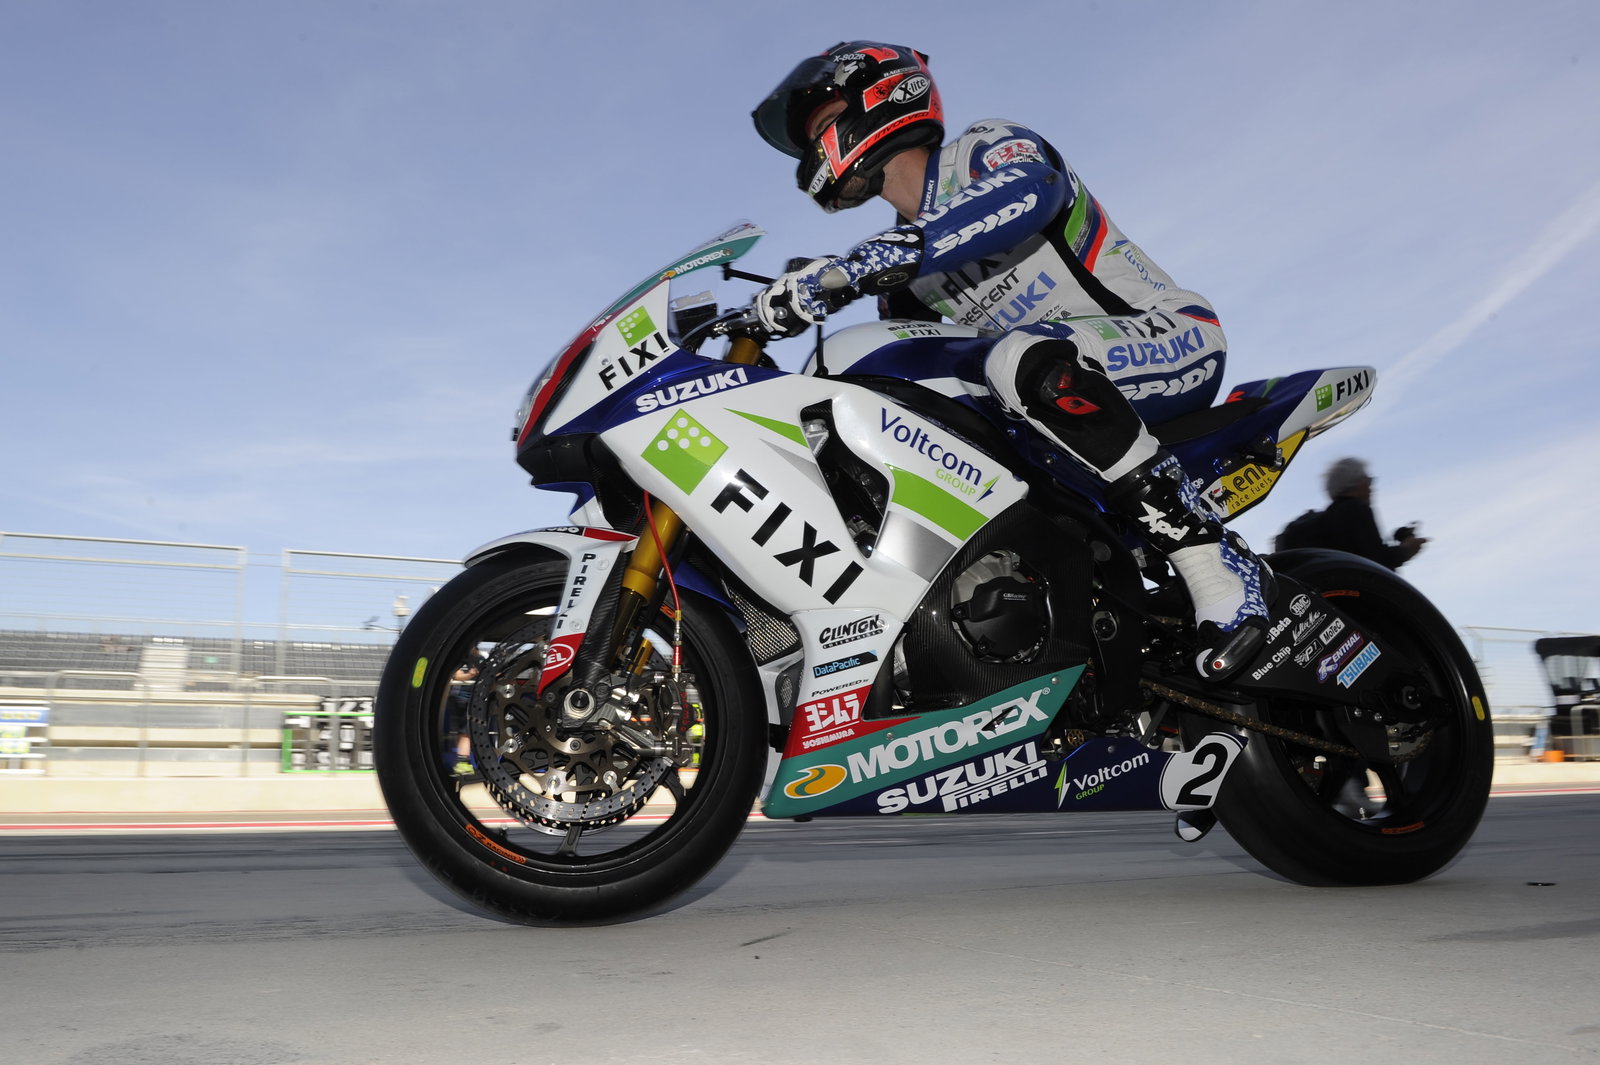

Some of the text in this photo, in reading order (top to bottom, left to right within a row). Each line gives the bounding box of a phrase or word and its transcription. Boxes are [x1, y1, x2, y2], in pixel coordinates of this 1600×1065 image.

[811, 174, 825, 191] FIXI
[922, 179, 935, 212] SUZUKI
[932, 193, 1038, 259] SPIDI
[674, 249, 727, 274] MOTOREX
[957, 267, 1020, 327] RESCENT
[888, 323, 933, 331] SUZUKI
[1110, 312, 1177, 339] FIXI
[598, 331, 670, 391] FIXI
[1106, 326, 1205, 372] SUZUKI
[635, 367, 749, 413] SUZUKI
[1335, 369, 1370, 402] FIXI
[881, 407, 982, 486] Voltcom
[935, 468, 977, 497] GROUP
[1231, 477, 1273, 510] race fuels
[710, 468, 864, 605] FIXI
[1291, 595, 1310, 614] BMC
[819, 614, 881, 645] CLINTON
[1270, 616, 1293, 641] Beta
[815, 657, 861, 676] DataPacific
[1252, 662, 1274, 681] Blue
[1271, 645, 1292, 666] Chip
[1338, 643, 1380, 687] TSUBAKI
[811, 680, 862, 697] POWERED
[804, 693, 860, 732] ヨシムラ
[803, 728, 855, 749] YOSHIMURA
[846, 690, 1049, 784] MOTOREX
[877, 741, 1040, 814] SUZUKI
[941, 760, 1049, 813] PIRELLI
[1073, 752, 1150, 791] Voltcom
[1175, 742, 1229, 806] 2
[1075, 784, 1105, 800] GROUP
